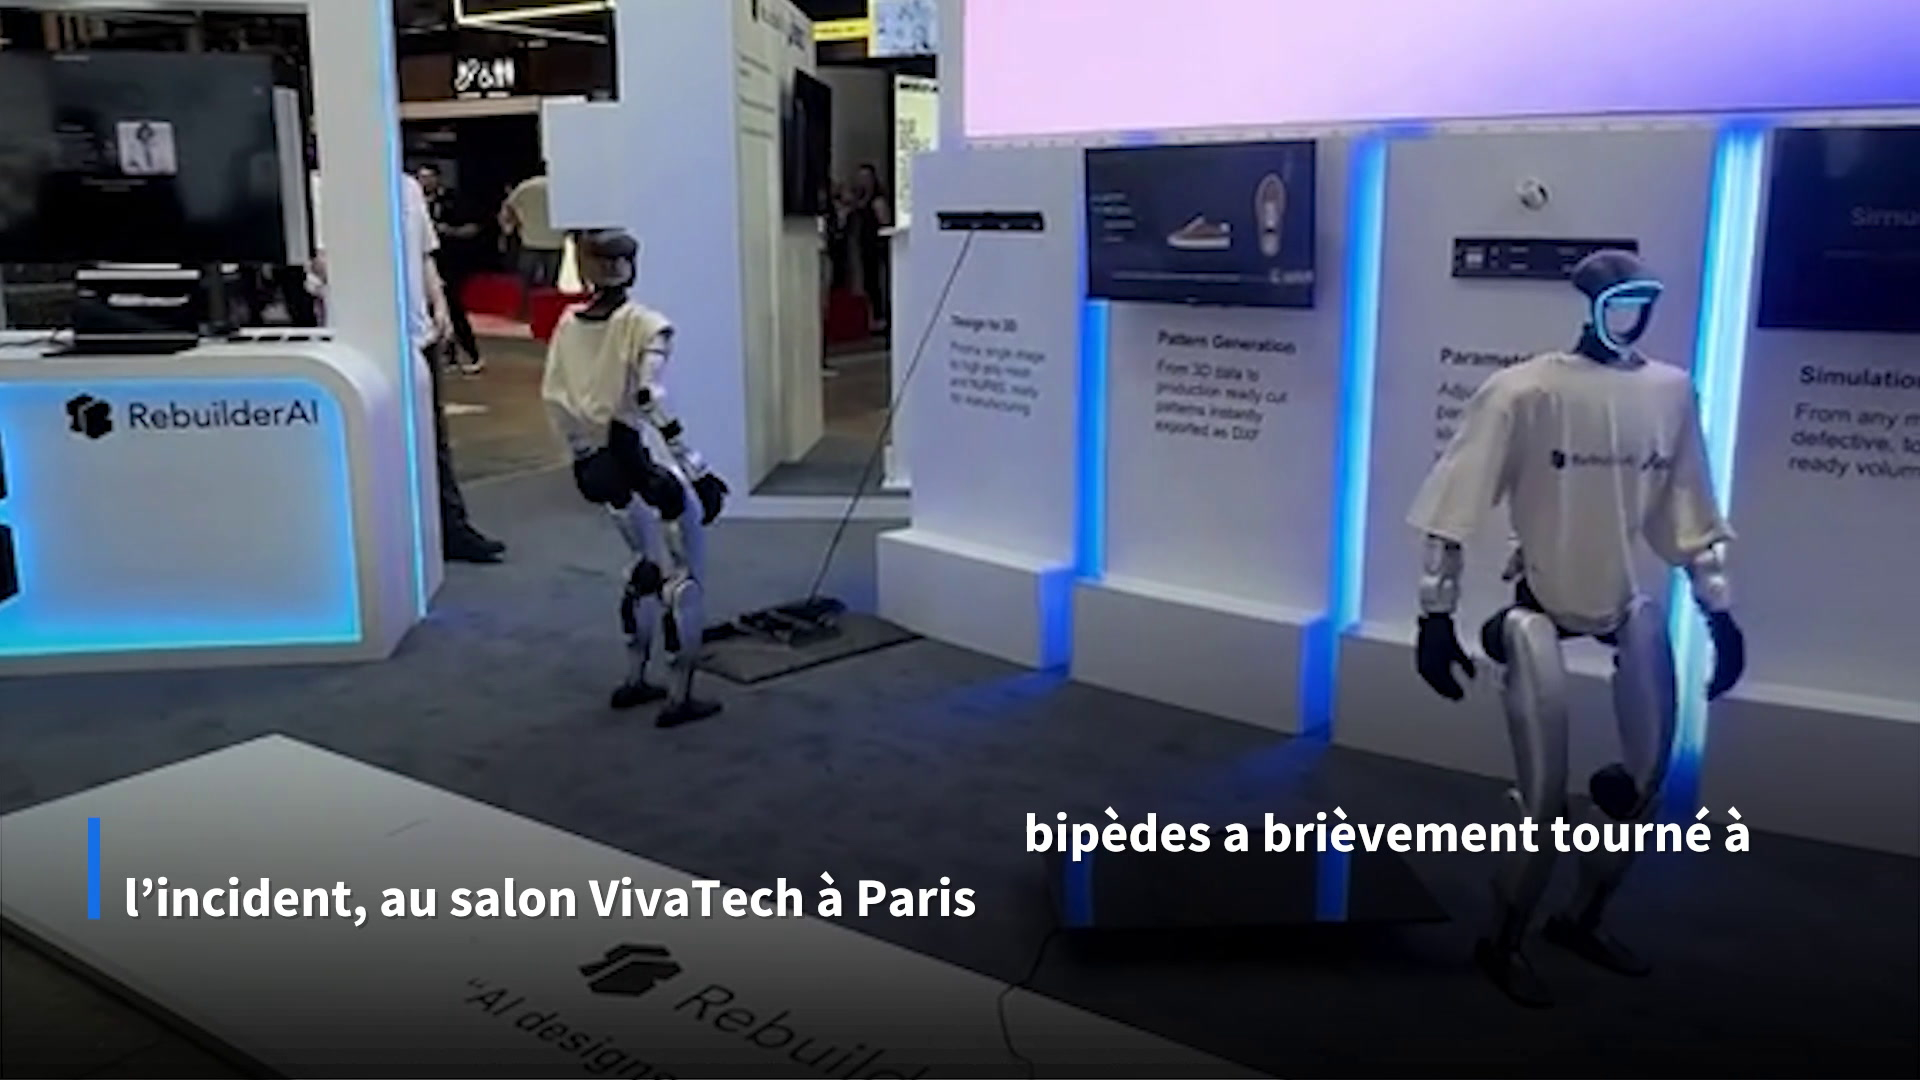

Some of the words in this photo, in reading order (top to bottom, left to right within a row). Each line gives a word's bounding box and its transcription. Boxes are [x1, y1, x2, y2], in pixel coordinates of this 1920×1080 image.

[1157, 328, 1208, 347] Pattern
[1211, 334, 1297, 354] Generation
[1156, 358, 1188, 373] From
[1191, 362, 1212, 377] 3D
[1799, 364, 1920, 390] Simulatio
[1156, 381, 1221, 398] production
[1225, 387, 1262, 405] ready
[1265, 391, 1288, 404] cut
[128, 399, 320, 430] RebuilderAI
[1794, 401, 1852, 423] From
[1857, 411, 1899, 431] any
[1788, 456, 1851, 479] ready
